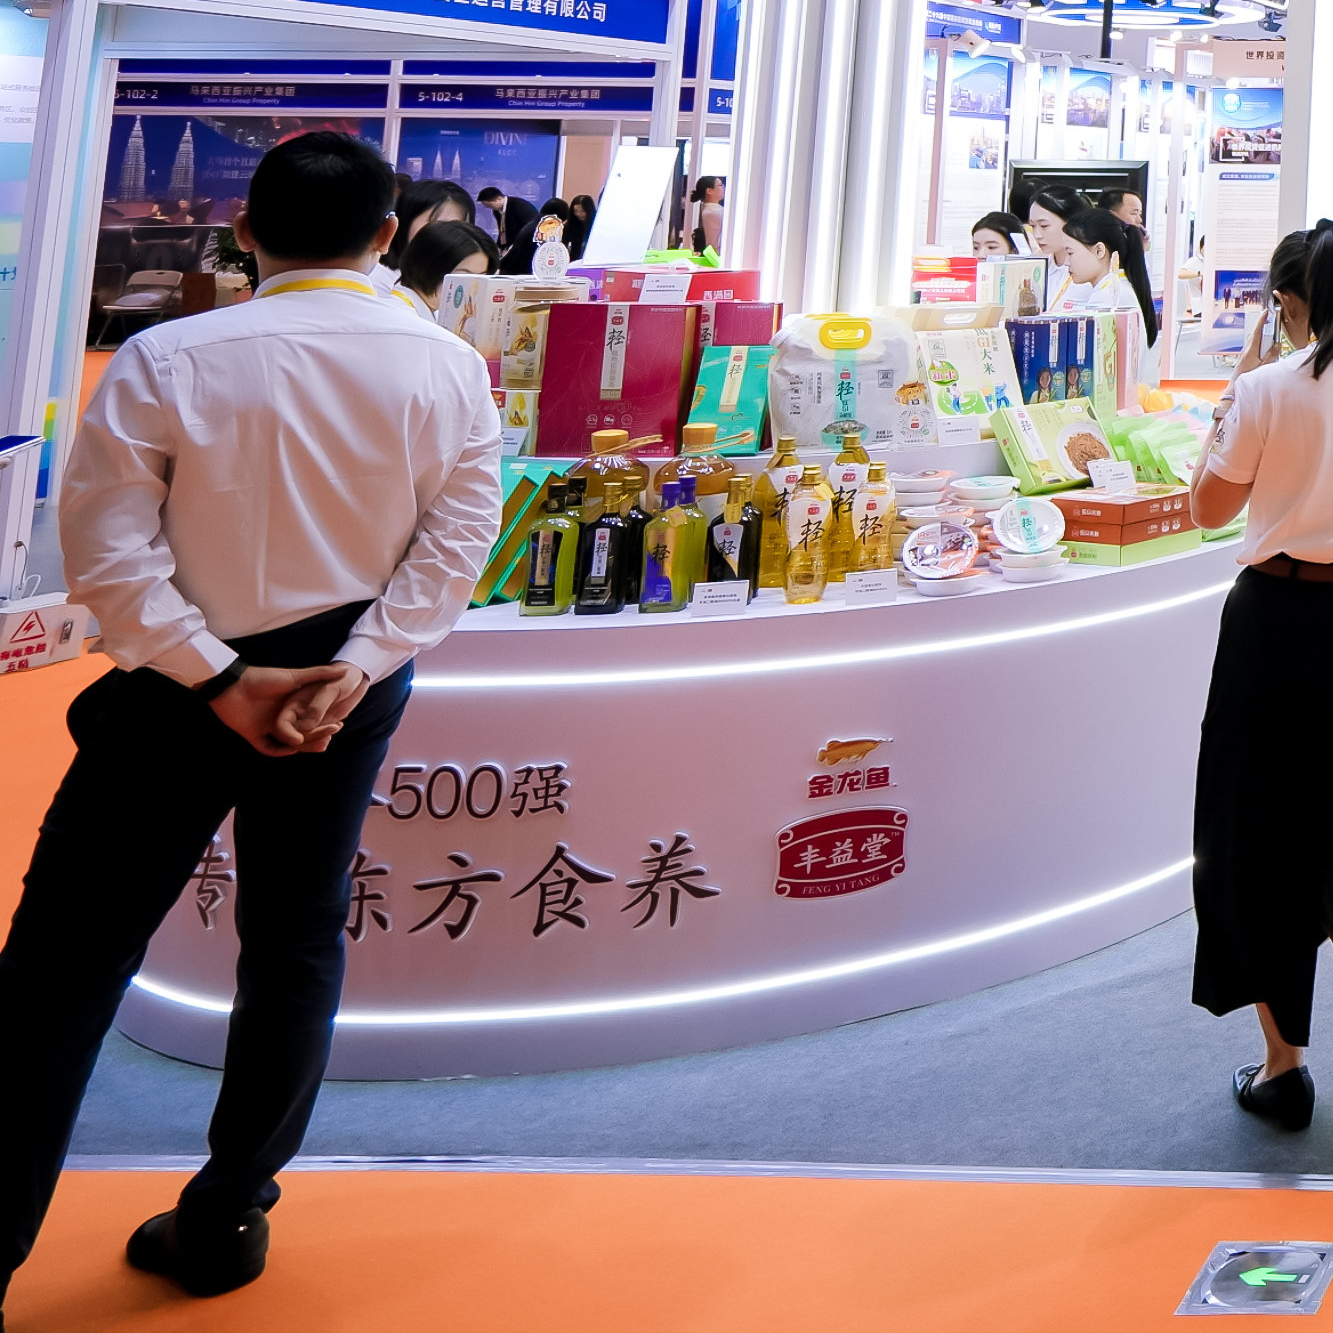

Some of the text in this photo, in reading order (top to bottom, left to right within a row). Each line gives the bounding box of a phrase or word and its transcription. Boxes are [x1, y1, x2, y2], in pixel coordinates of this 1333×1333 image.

[418, 91, 464, 102] 5-102-4
[495, 88, 601, 100] 马来西亚振兴产业集团
[607, 328, 625, 351] 轻
[728, 363, 743, 378] 轻
[836, 380, 854, 401] 轻
[833, 487, 858, 523] 轻
[798, 518, 826, 552] 轻
[858, 514, 884, 545] 轻
[652, 543, 671, 562] 轻
[718, 539, 737, 557] 轻
[371, 763, 569, 821] 500强
[807, 765, 891, 798] 金龙鱼
[794, 832, 892, 875] 丰益堂
[802, 873, 880, 895] FENG YI TANG
